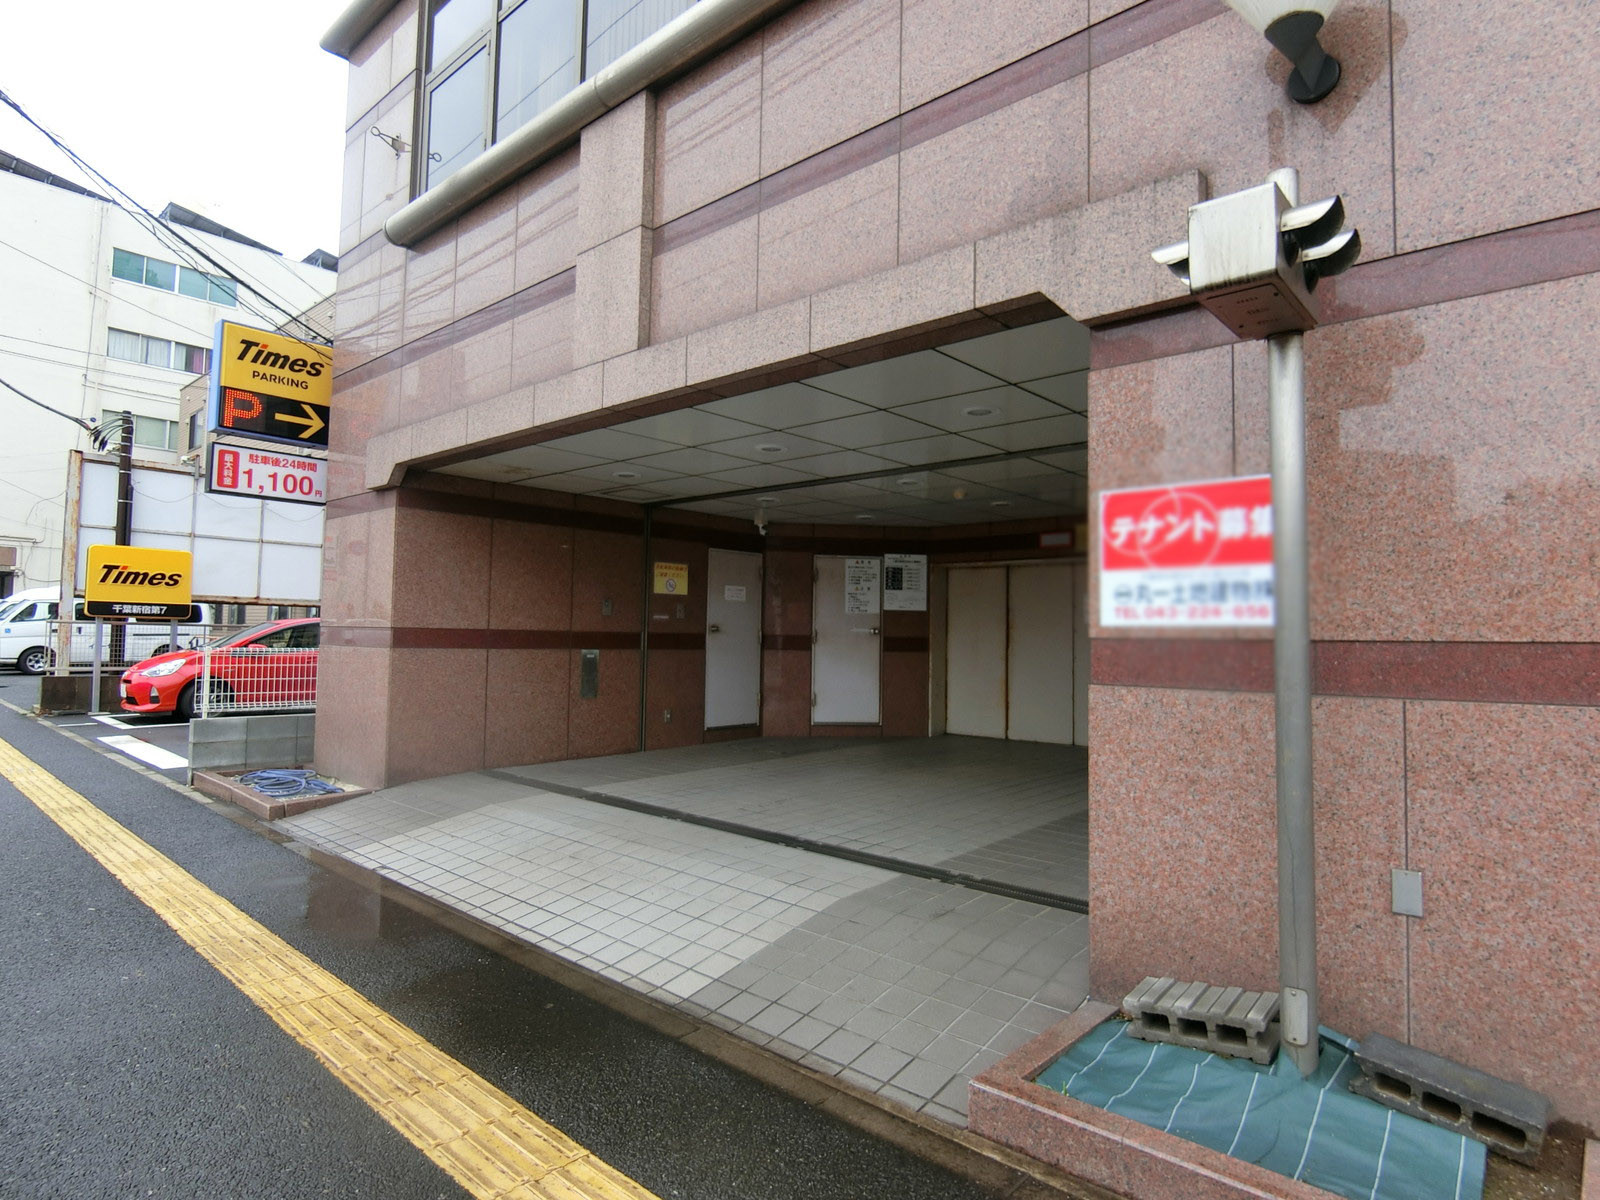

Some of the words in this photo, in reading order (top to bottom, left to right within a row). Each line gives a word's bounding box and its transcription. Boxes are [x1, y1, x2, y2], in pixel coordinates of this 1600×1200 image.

[237, 339, 325, 377] Times
[252, 370, 309, 390] PARKING
[223, 388, 263, 427] P
[223, 453, 234, 486] 最大料金
[248, 453, 318, 473] 駐車後24時間
[99, 564, 183, 587] Times
[112, 604, 168, 615] 千葉新宿第7
